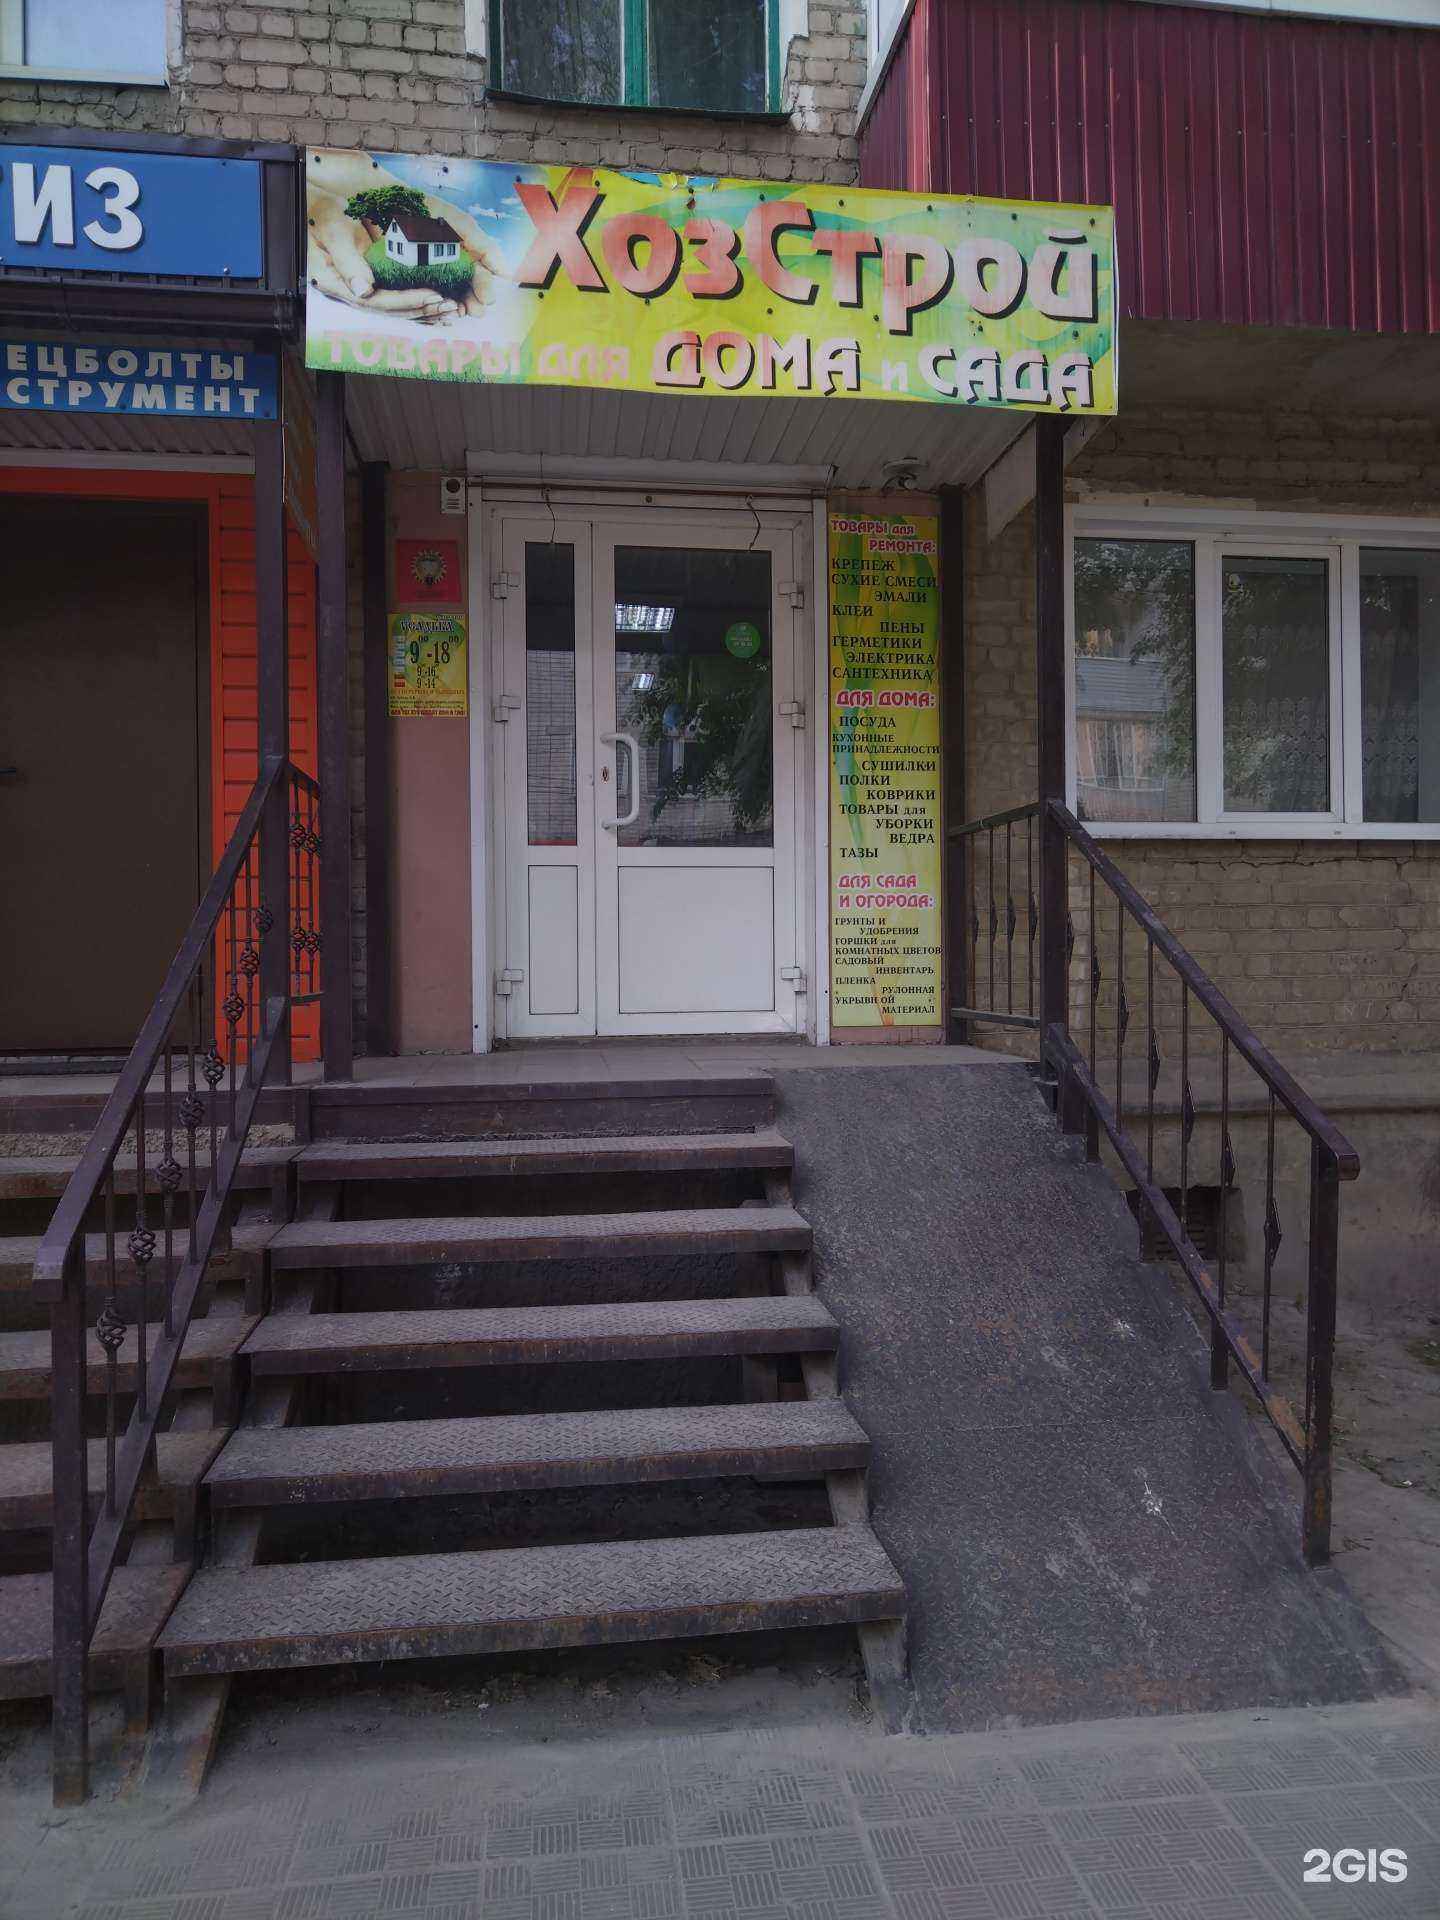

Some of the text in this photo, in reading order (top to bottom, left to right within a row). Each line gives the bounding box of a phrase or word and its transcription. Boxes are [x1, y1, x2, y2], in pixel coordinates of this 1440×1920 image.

[6, 344, 244, 381] ЕЦБОЛТЫ
[322, 331, 521, 375] ТОВАРЫ
[651, 331, 861, 397] ДОМА
[919, 344, 1094, 412] САДА
[6, 377, 260, 413] СТРУМЕНТ
[832, 520, 888, 533] ТОВАРЫ
[869, 539, 936, 553] РЕМОНТА:
[832, 558, 896, 571] КРЕПЕЖ
[832, 574, 937, 587] СУХИЕ СМЕСИ
[874, 591, 927, 603] ЭМАЛИ
[880, 621, 924, 634] ПЕНЫ
[832, 636, 922, 649] ГЕРМЕТИКИ
[847, 652, 935, 665] ЭЛЕКТРИКА
[832, 667, 933, 680] САНТЕХНИКА
[837, 691, 936, 707] ДЛЯ ДОМА:
[839, 716, 896, 728] ПОСУДА
[832, 734, 895, 742] КУХОННЫЕ
[832, 745, 940, 754] ПРИНАДЛЕЖНОСТИ
[862, 760, 936, 772] СУШИЛКИ
[839, 775, 891, 786] ПОЛКИ
[866, 789, 936, 800] КОВРИКИ
[839, 804, 926, 816] ТОВАРЫ для
[876, 818, 934, 829] УБОРКИ
[889, 833, 935, 845] ВЕДРА
[839, 847, 879, 858] ТАЗЫ
[839, 875, 917, 888] ДЛЯ САДА
[839, 894, 934, 909] И ОГОРОДА:
[835, 917, 886, 926] ГРУНТЫ И
[860, 927, 919, 936] УДОБРЕНИЯ
[835, 937, 878, 945] ГОРШКИ
[835, 947, 942, 956] КОМНАТНЫХ ЦВЕТОВ
[835, 956, 884, 965] САДОВЫЙ
[876, 966, 935, 975] ИНВЕНТАРЬ
[835, 976, 876, 985] ПЛЕНКА
[882, 986, 935, 994] РУЛОННАЯ
[835, 996, 895, 1004] УКРЫВНОЙ
[882, 1005, 935, 1014] МАТЕРИАЛ
